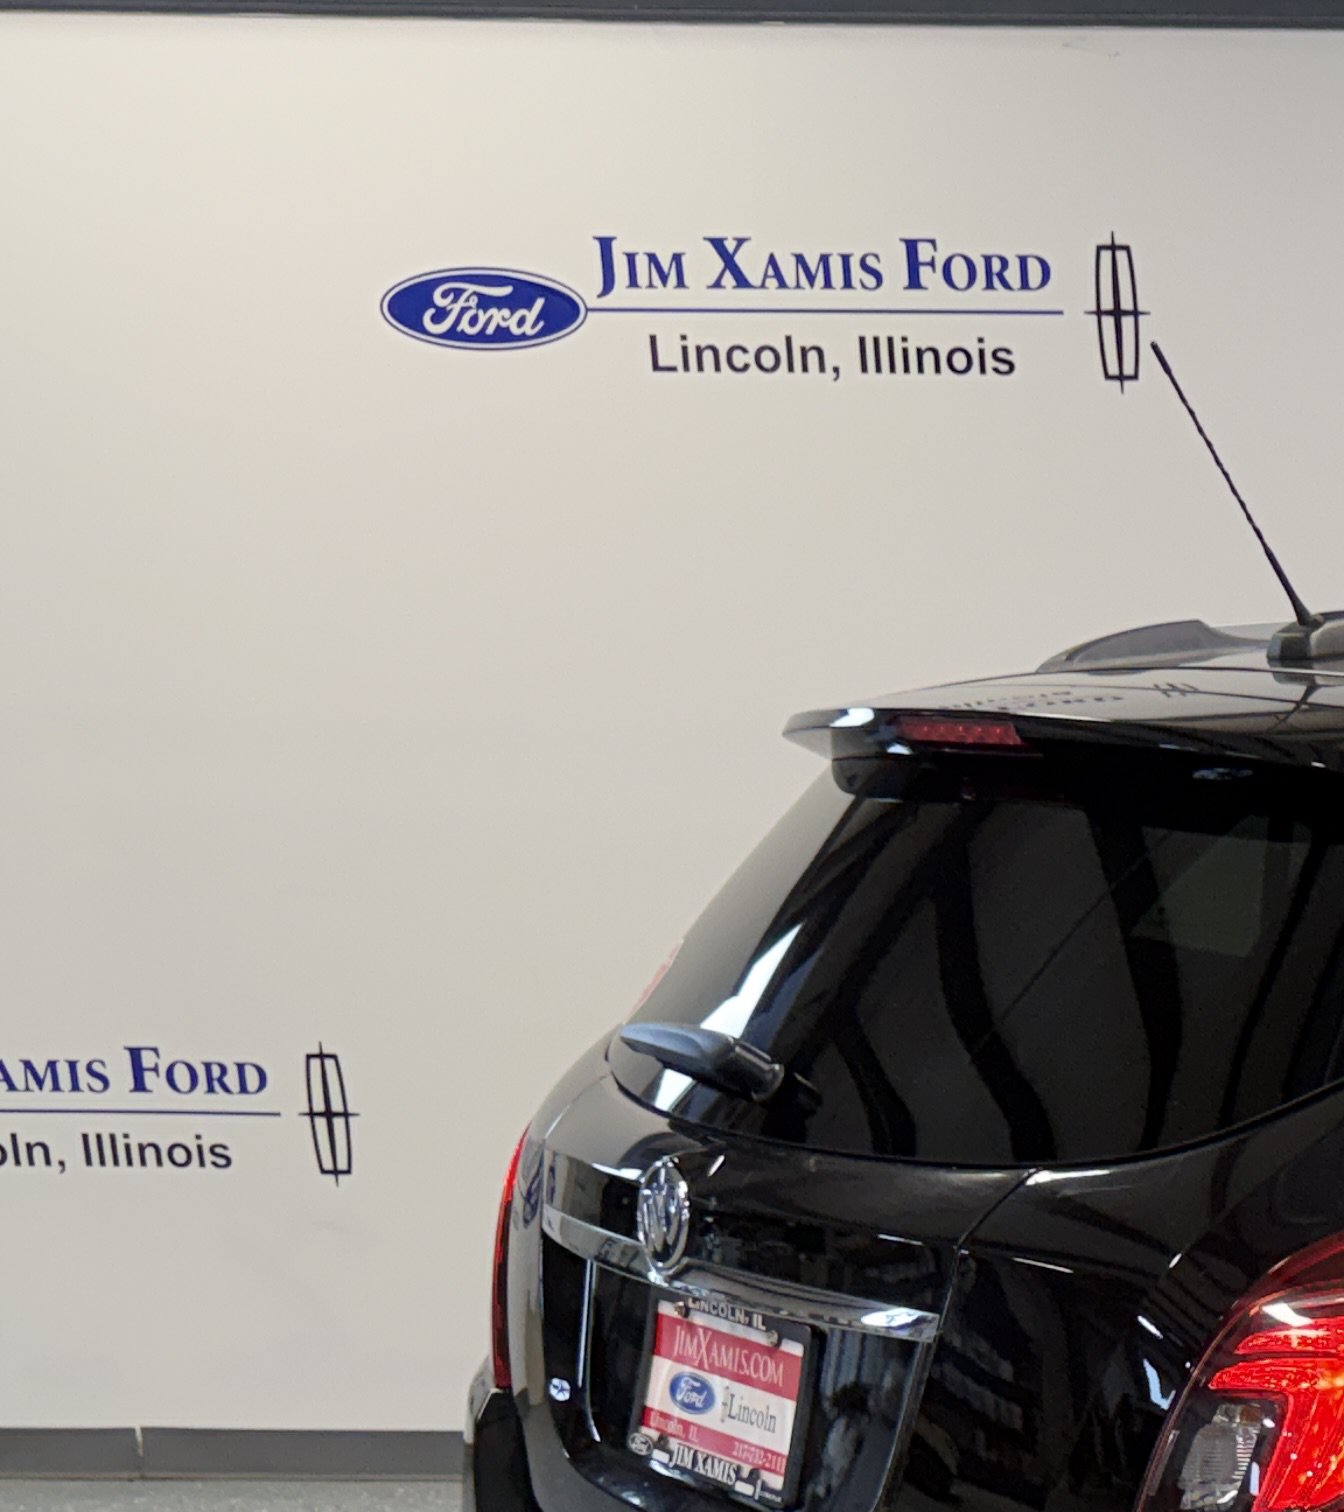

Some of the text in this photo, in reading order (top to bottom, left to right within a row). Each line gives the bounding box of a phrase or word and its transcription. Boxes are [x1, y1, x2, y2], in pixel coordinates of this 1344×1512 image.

[592, 236, 1051, 298] JIM XAMIS FORD
[422, 280, 545, 338] Ford
[648, 333, 1016, 382] Lincoln, Illinois
[124, 1046, 268, 1094] FORD
[82, 1133, 233, 1169] Illinois
[752, 1313, 767, 1331] IL
[688, 1425, 699, 1442] IL
[728, 1393, 777, 1433] Lincoln
[669, 1443, 739, 1487] JIM XAMIS
